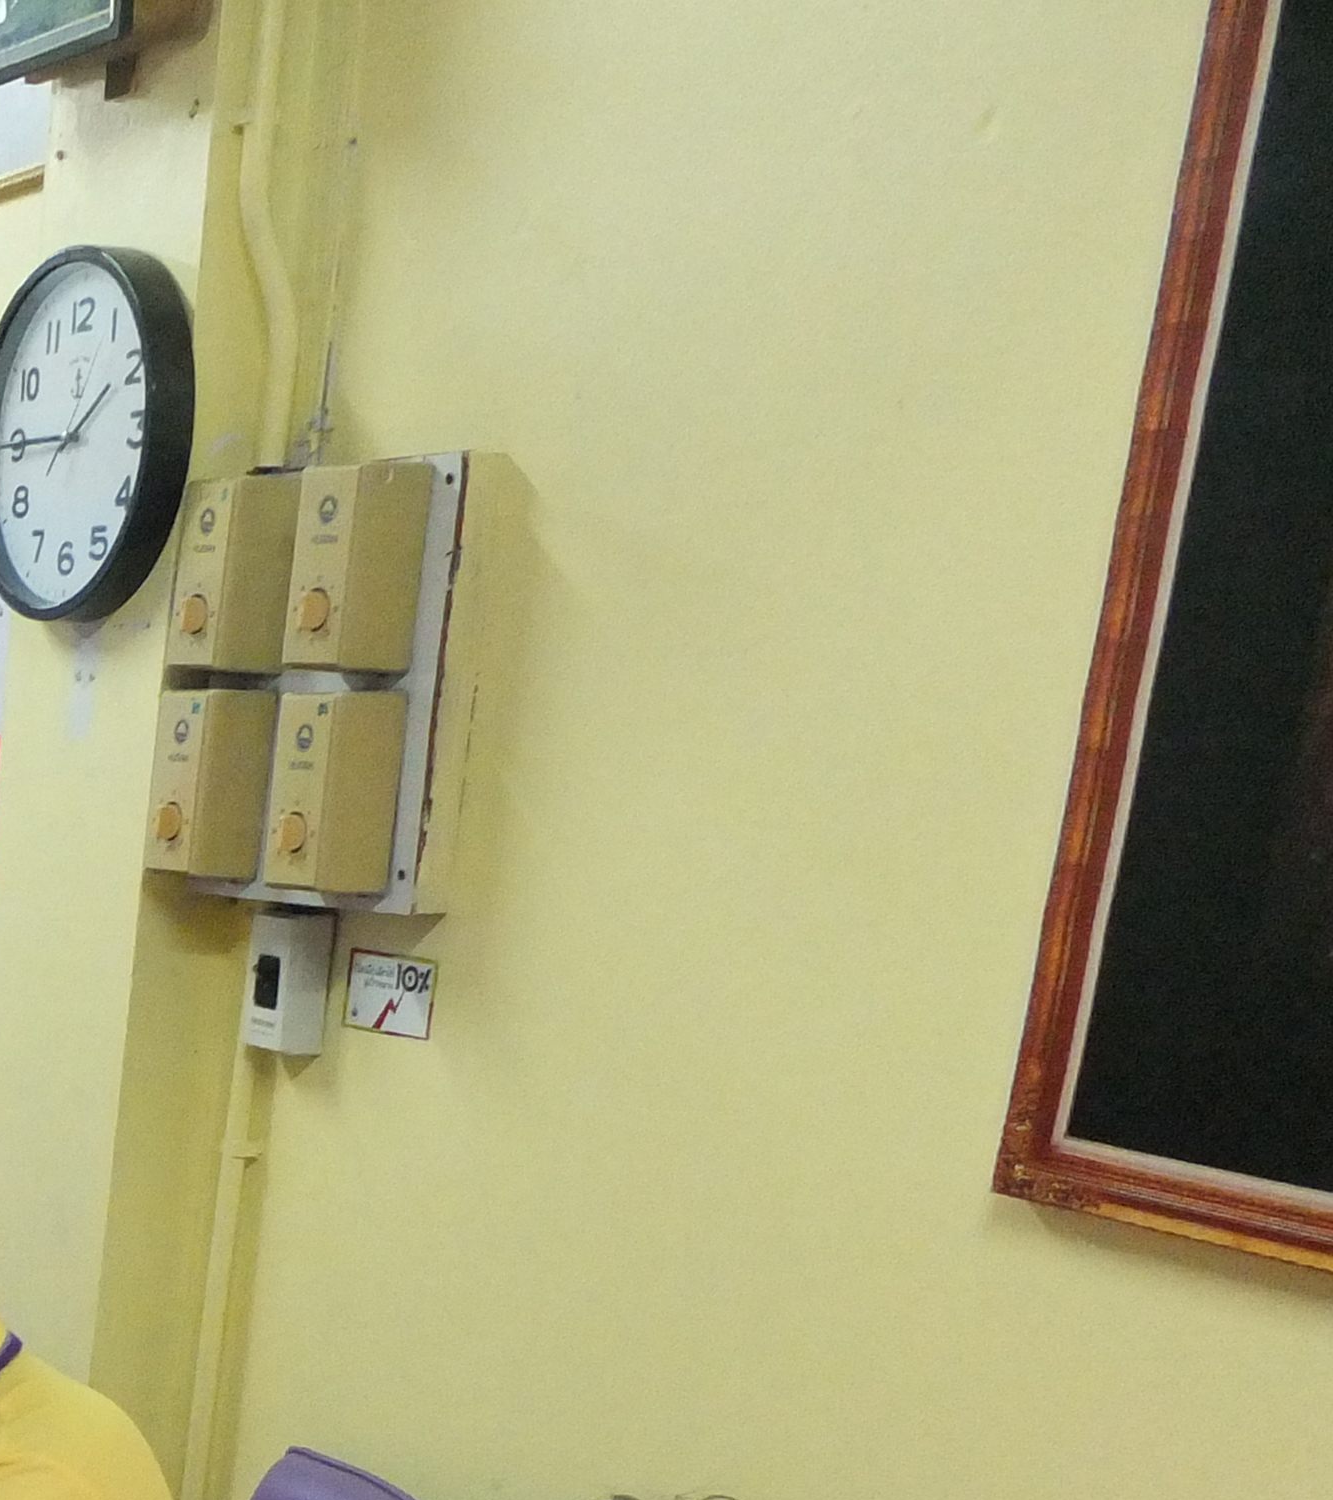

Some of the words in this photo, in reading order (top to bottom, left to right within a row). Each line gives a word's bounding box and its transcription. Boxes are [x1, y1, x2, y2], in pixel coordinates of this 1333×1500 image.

[71, 298, 94, 334] 12
[111, 308, 117, 343] 1
[46, 320, 61, 355] 11
[20, 367, 40, 402] 10
[124, 349, 144, 385] 2
[10, 429, 27, 462] 9
[126, 410, 145, 449] 3
[12, 486, 29, 518] 8
[114, 475, 133, 508] 4
[32, 530, 45, 564] 7
[57, 541, 74, 576] 6
[88, 525, 108, 561] 5
[394, 962, 431, 994] 10%
